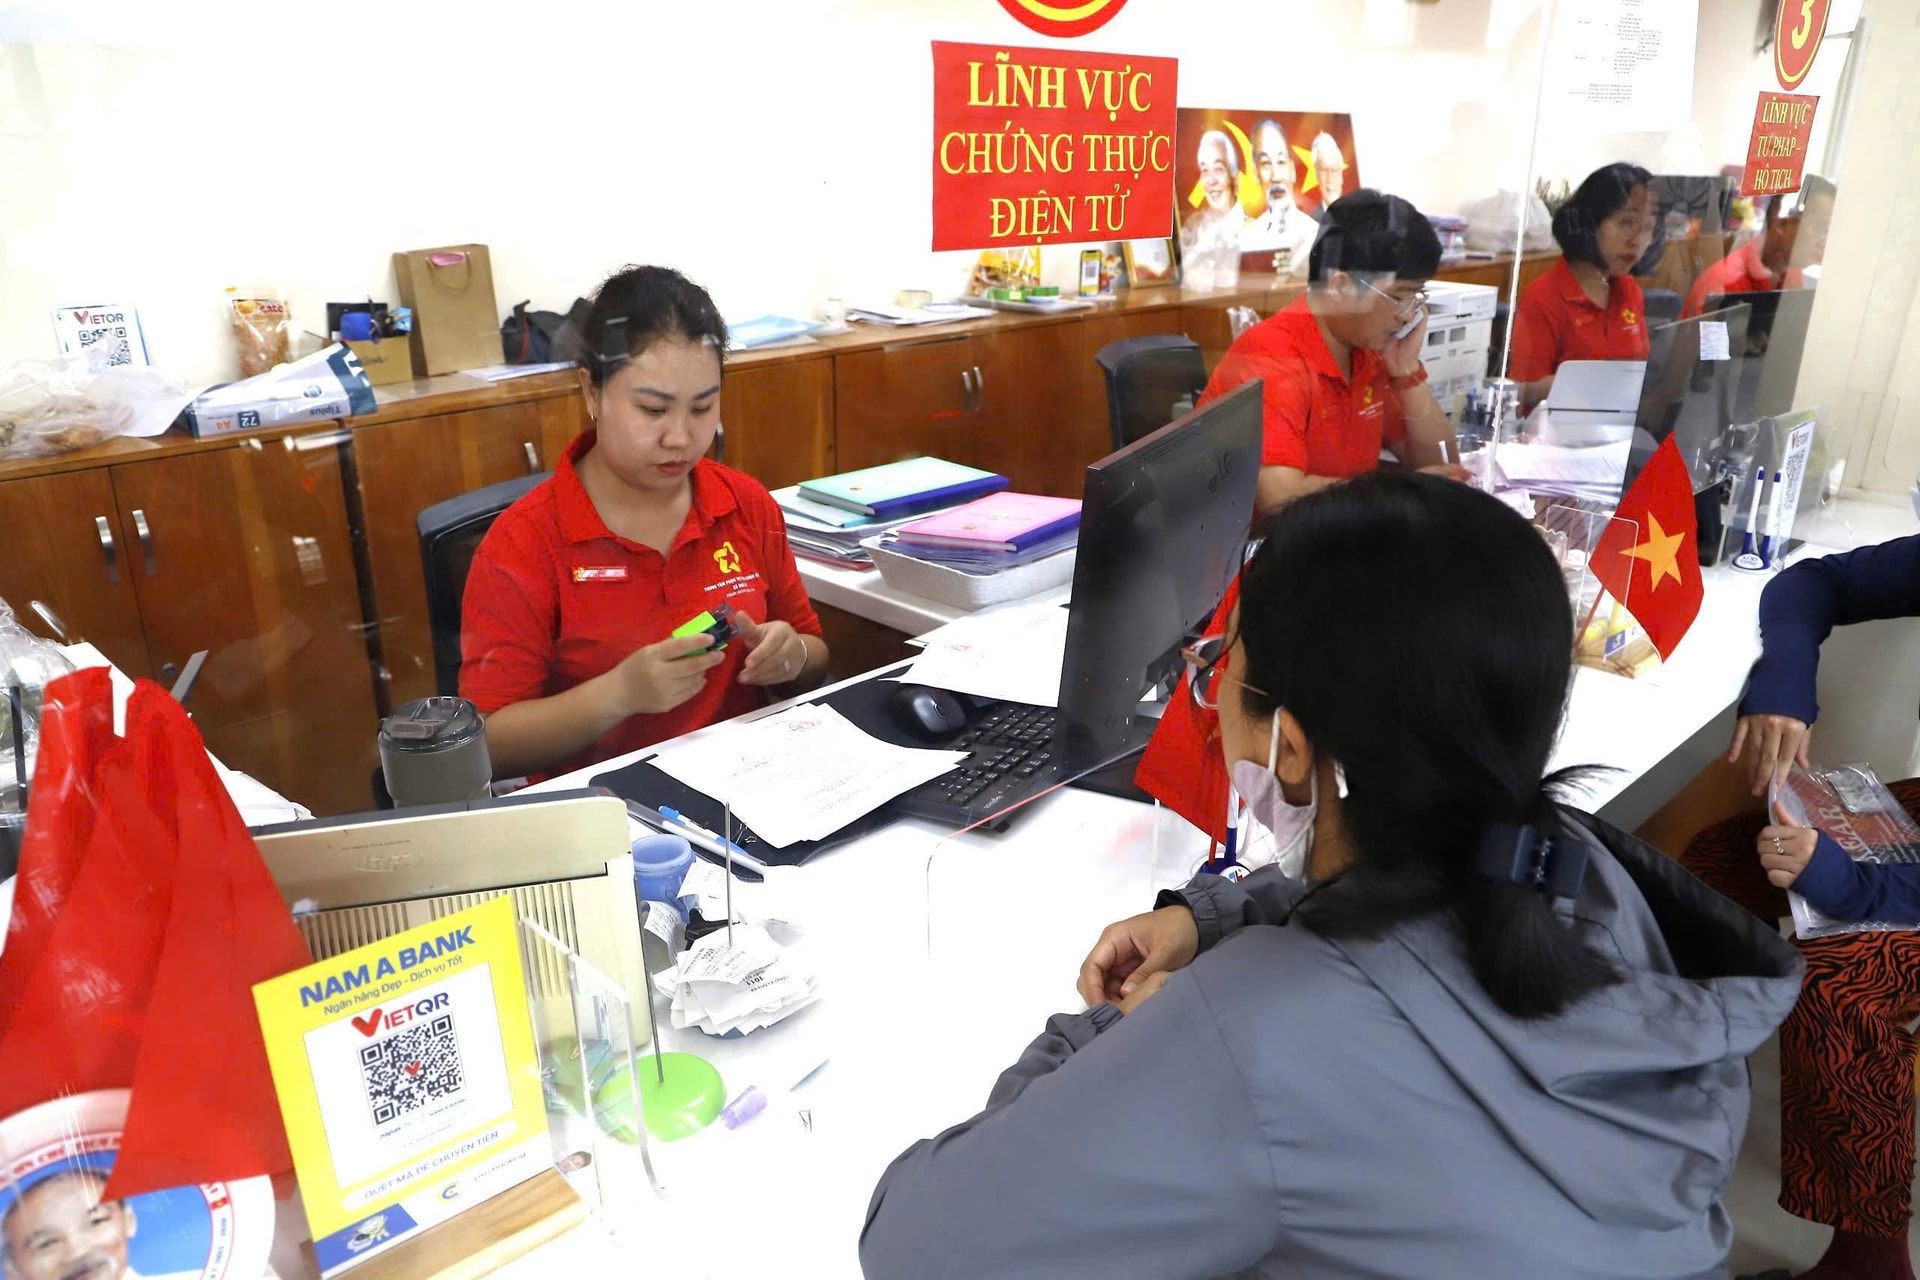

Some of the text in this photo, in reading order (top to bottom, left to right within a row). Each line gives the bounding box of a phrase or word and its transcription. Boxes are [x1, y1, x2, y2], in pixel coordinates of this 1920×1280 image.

[1791, 0, 1815, 50] 3
[967, 51, 1152, 122] LĨNH VỰC
[1761, 95, 1811, 130] LĨNH VỰC
[940, 120, 1170, 180] CHỨNG THỰC
[1757, 133, 1773, 157] TƯ
[1753, 163, 1792, 194] HỘ TỊCH
[990, 184, 1131, 243] ĐIỆN TỬ
[73, 310, 124, 325] VIETQR
[240, 416, 258, 427] 72
[309, 404, 341, 416] Tiplus
[299, 924, 476, 1008] NAM A BANK
[323, 995, 353, 1016] Ngân
[381, 978, 403, 998] Đẹp
[410, 967, 433, 984] Dịch
[447, 954, 464, 970] Tốt
[350, 991, 451, 1038] VIETQR
